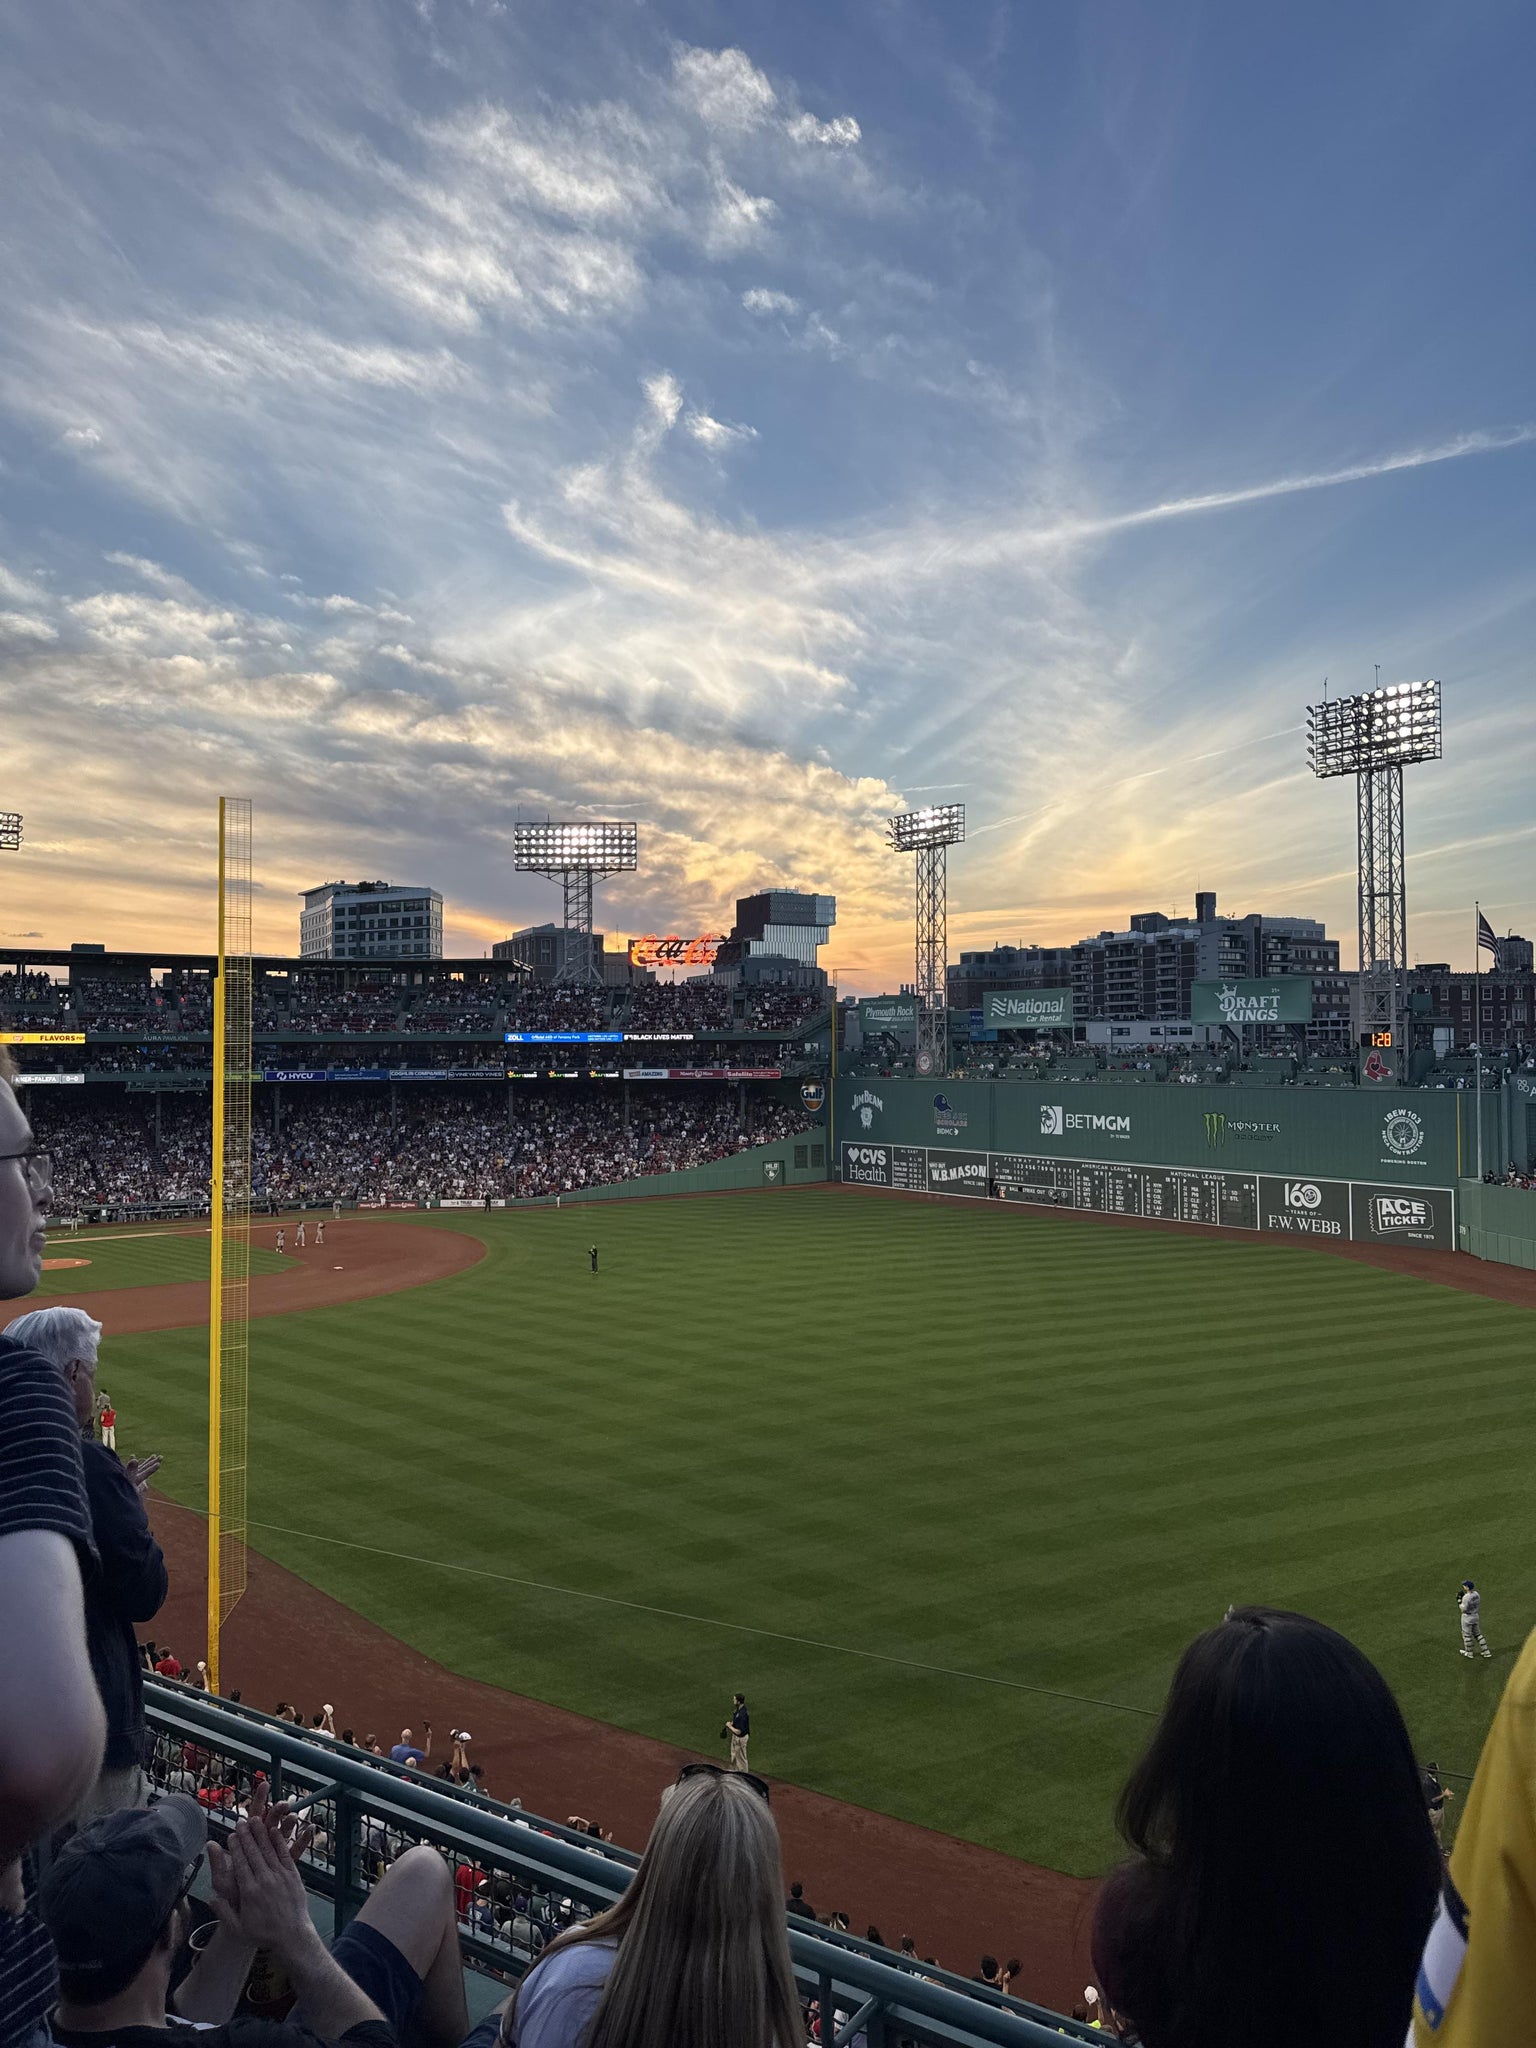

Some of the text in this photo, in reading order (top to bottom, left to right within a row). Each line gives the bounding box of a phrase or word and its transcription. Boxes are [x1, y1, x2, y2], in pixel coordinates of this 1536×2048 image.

[865, 1005, 914, 1018] Plymouth Rock
[1006, 997, 1064, 1014] National
[1219, 996, 1280, 1012] DRAFT
[1226, 1008, 1278, 1022] KINGS
[1372, 1032, 1392, 1047] 1:28
[802, 1087, 823, 1099] Gulf
[852, 1090, 883, 1112] JIM BEAM
[1066, 1114, 1130, 1131] BETMGM
[1384, 1109, 1422, 1124] IBEW 103
[1228, 1121, 1280, 1132] MONSTER
[1381, 1130, 1390, 1147] NECA
[1389, 1132, 1424, 1155] CONTRACTORS
[860, 1148, 886, 1166] CVS
[849, 1164, 887, 1182] Health
[1284, 1182, 1322, 1208] 160
[1382, 1198, 1426, 1215] ACE
[1268, 1214, 1341, 1235] F.W. WEBB
[1382, 1216, 1426, 1226] TICKET
